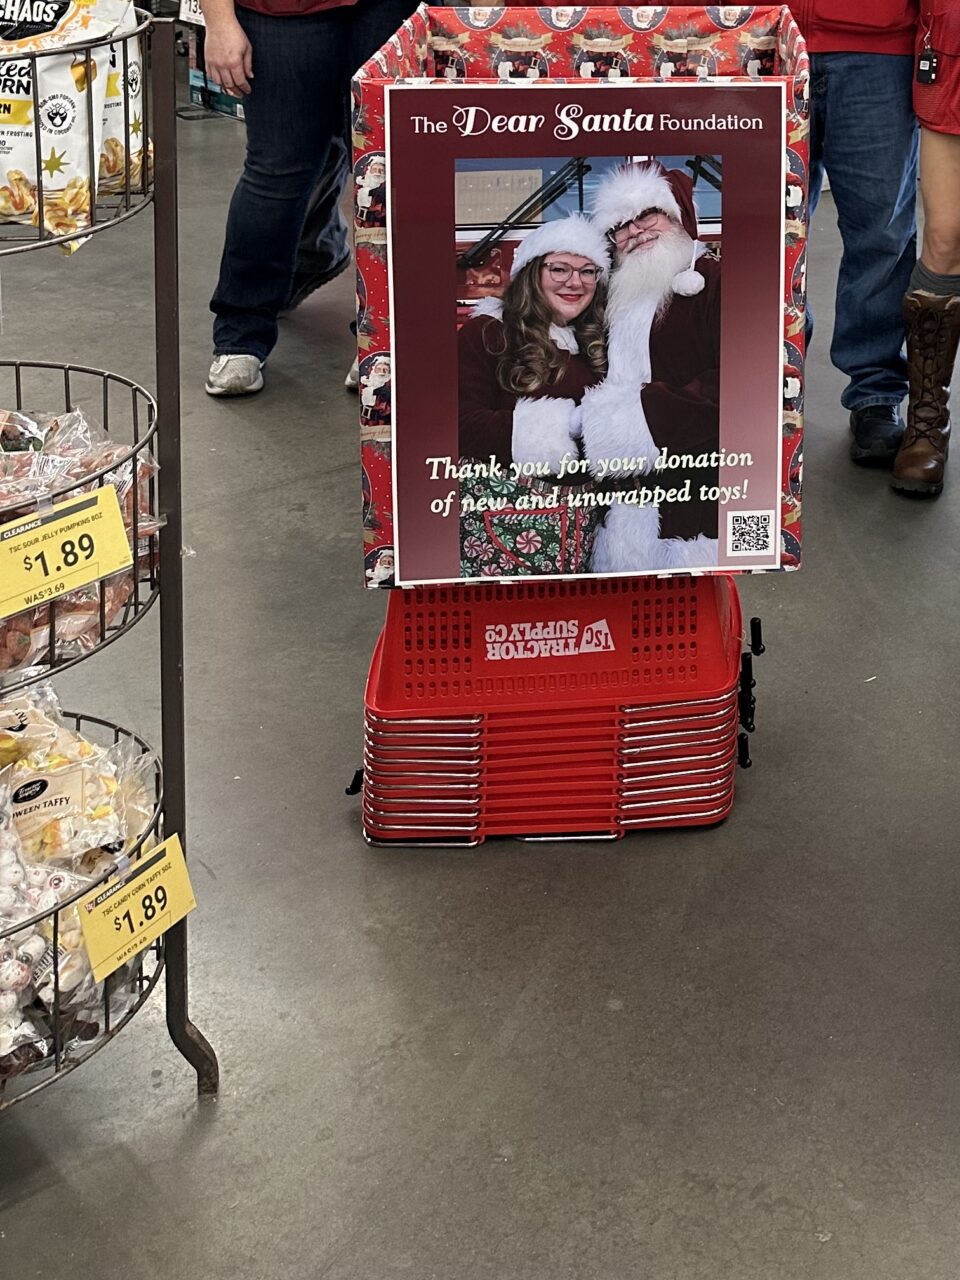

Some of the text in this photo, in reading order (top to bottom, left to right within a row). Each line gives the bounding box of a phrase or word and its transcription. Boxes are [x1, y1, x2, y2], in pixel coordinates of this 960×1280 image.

[0, 78, 31, 95] RN
[411, 103, 763, 140] The Dear Santa Foundation
[425, 447, 754, 481] Thank you for your donation
[430, 479, 749, 517] of new and unwrapped toys!
[3, 520, 42, 539] CLEARANCE
[9, 544, 21, 555] TSC
[23, 536, 40, 548] SOUR
[41, 530, 58, 542] JELLY
[60, 517, 91, 534] PUMPKINS
[23, 533, 95, 577] $1.89
[508, 620, 579, 641] SUPPLY
[584, 626, 612, 651] TSC
[486, 638, 579, 660] TRACTOR
[43, 796, 70, 808] TAFFY
[102, 906, 113, 917] TSC
[113, 893, 131, 909] CANDY
[131, 882, 147, 897] CORN
[146, 870, 162, 886] TAFFY
[114, 885, 168, 934] $1.89
